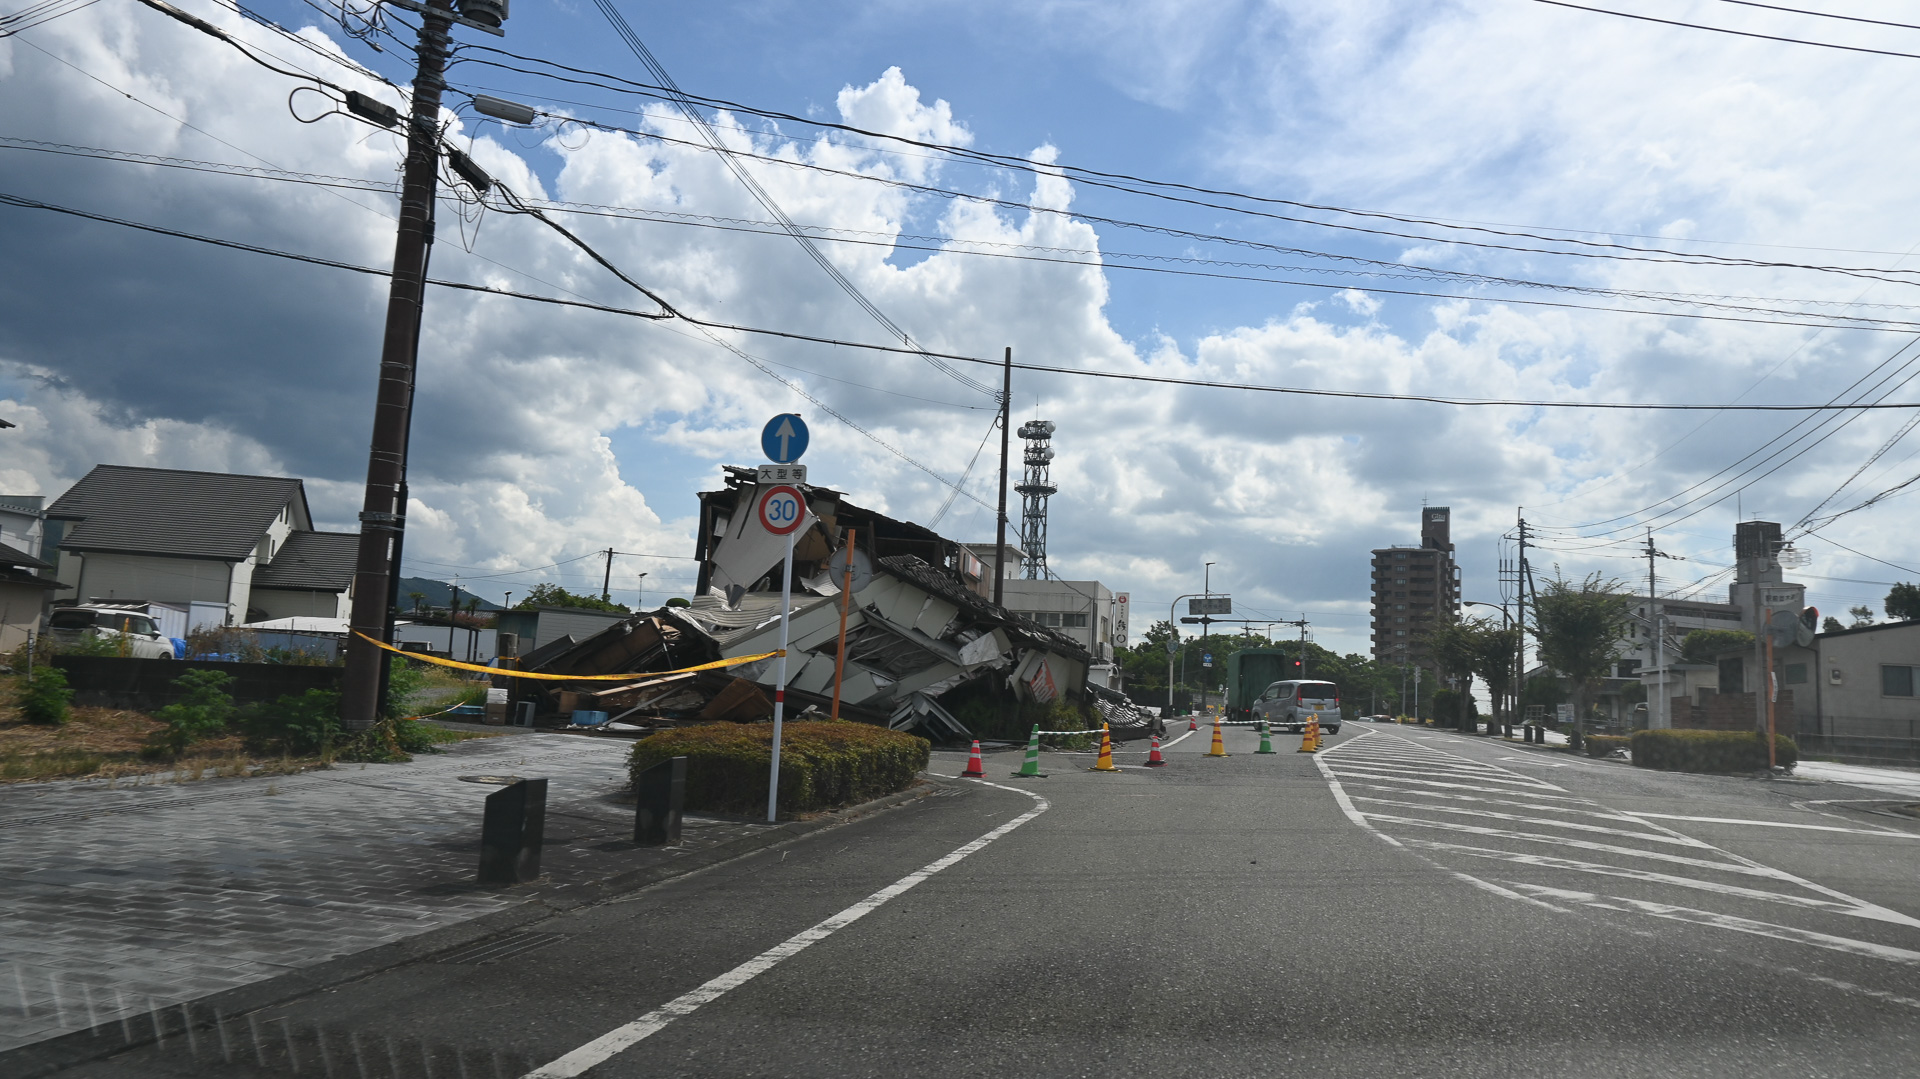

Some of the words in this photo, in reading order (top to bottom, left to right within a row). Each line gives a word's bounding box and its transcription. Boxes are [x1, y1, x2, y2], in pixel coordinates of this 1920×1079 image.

[760, 468, 803, 480] 大型等
[769, 499, 796, 521] 30
